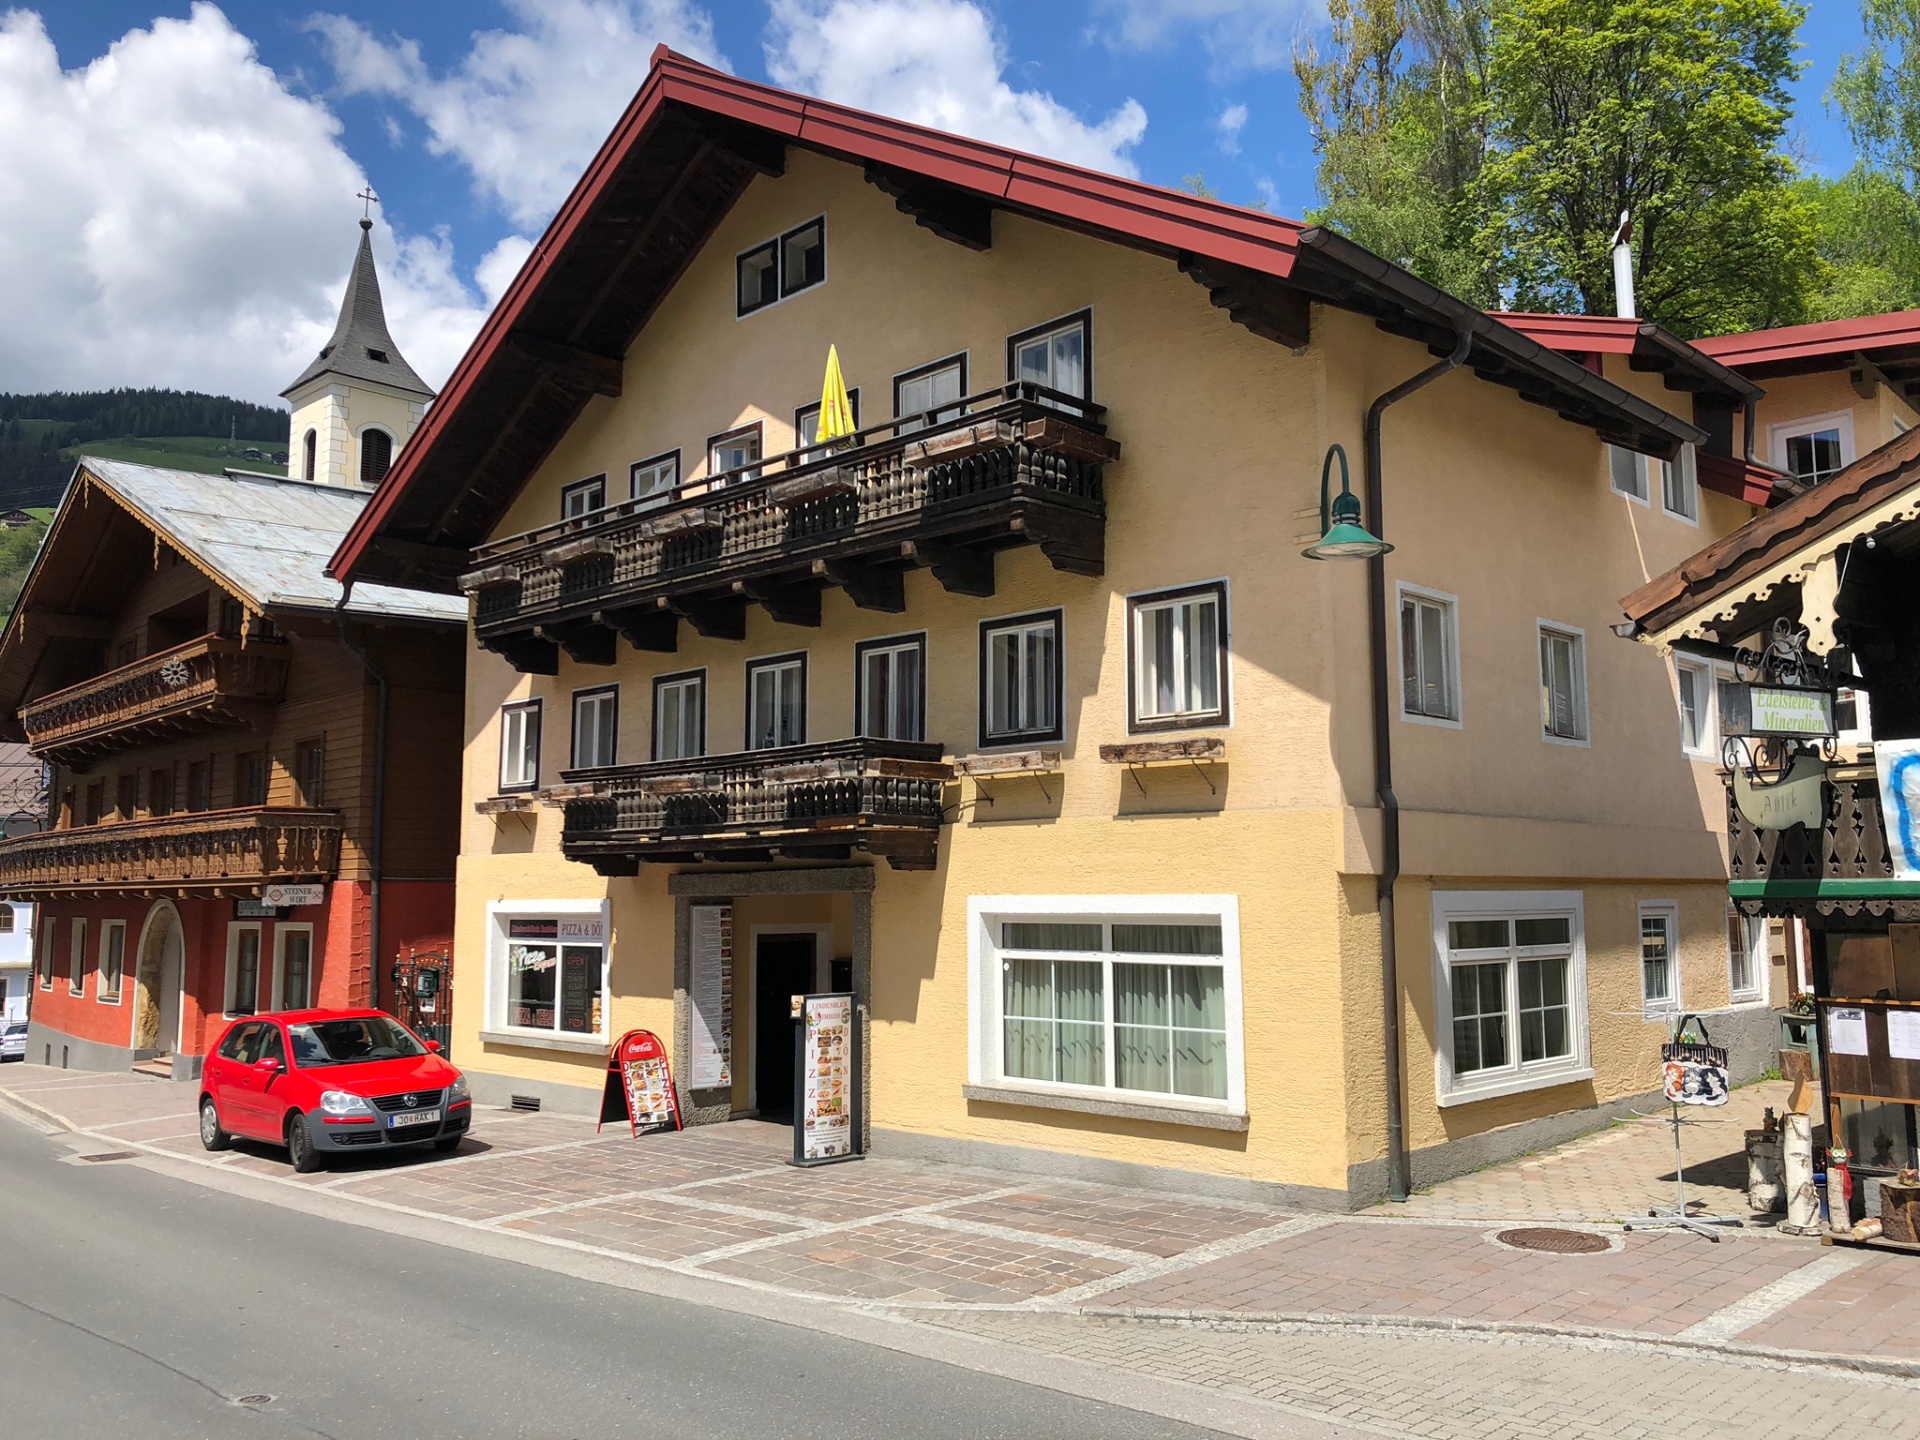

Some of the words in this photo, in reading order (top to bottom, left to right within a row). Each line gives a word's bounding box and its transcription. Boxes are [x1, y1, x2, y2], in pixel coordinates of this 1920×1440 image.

[1757, 688, 1815, 710] Edelsteine
[1819, 692, 1827, 711] &
[1763, 711, 1825, 731] Mineralien
[284, 887, 312, 895] STEINER
[561, 924, 582, 936] PIZZA
[584, 924, 590, 936] &
[812, 1001, 848, 1010] LINDENBLICK
[628, 1042, 653, 1054] Coca-Cola
[808, 1029, 817, 1118] PIZZA
[659, 1058, 674, 1111] PIZZA
